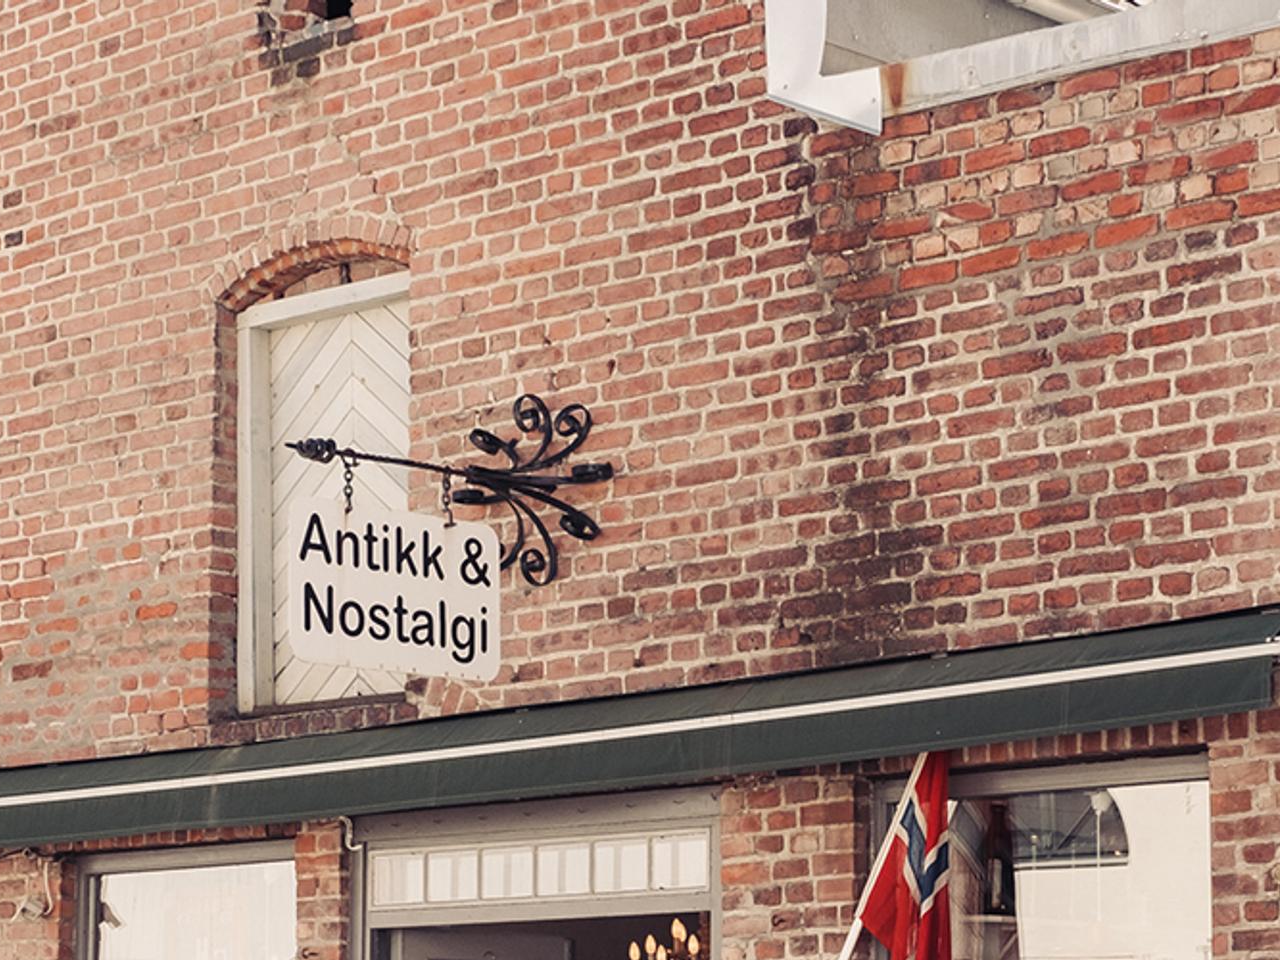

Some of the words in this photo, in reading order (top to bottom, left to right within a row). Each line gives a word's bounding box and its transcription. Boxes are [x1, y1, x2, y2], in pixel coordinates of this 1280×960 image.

[299, 512, 445, 581] Antikk
[460, 537, 491, 588] &
[304, 582, 488, 664] Nostalgi
